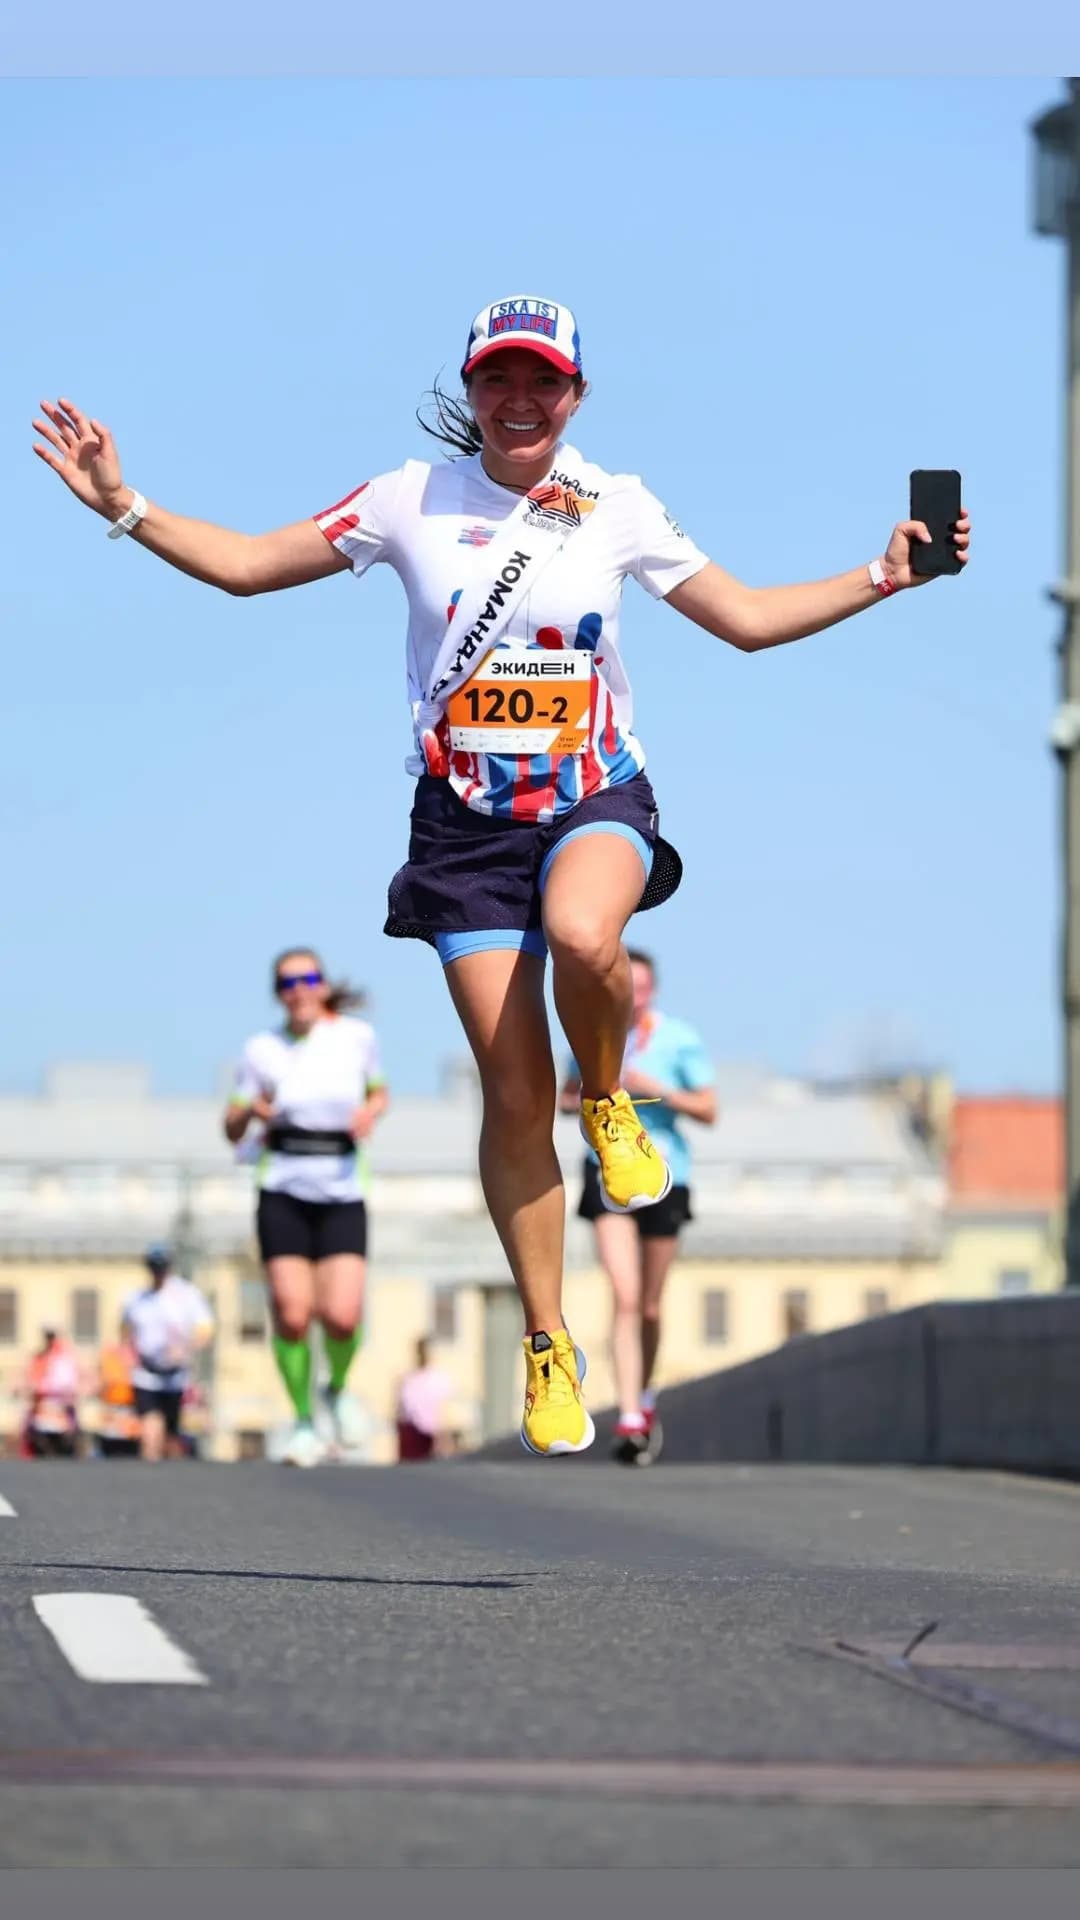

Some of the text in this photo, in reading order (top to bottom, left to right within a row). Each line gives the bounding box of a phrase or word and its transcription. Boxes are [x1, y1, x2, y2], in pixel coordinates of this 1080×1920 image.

[498, 300, 550, 317] SKA IS
[493, 315, 553, 336] MY LIFE
[450, 550, 532, 673] КОМАНДА
[491, 662, 575, 677] ЭКИДЕН
[464, 688, 568, 723] 120-2
